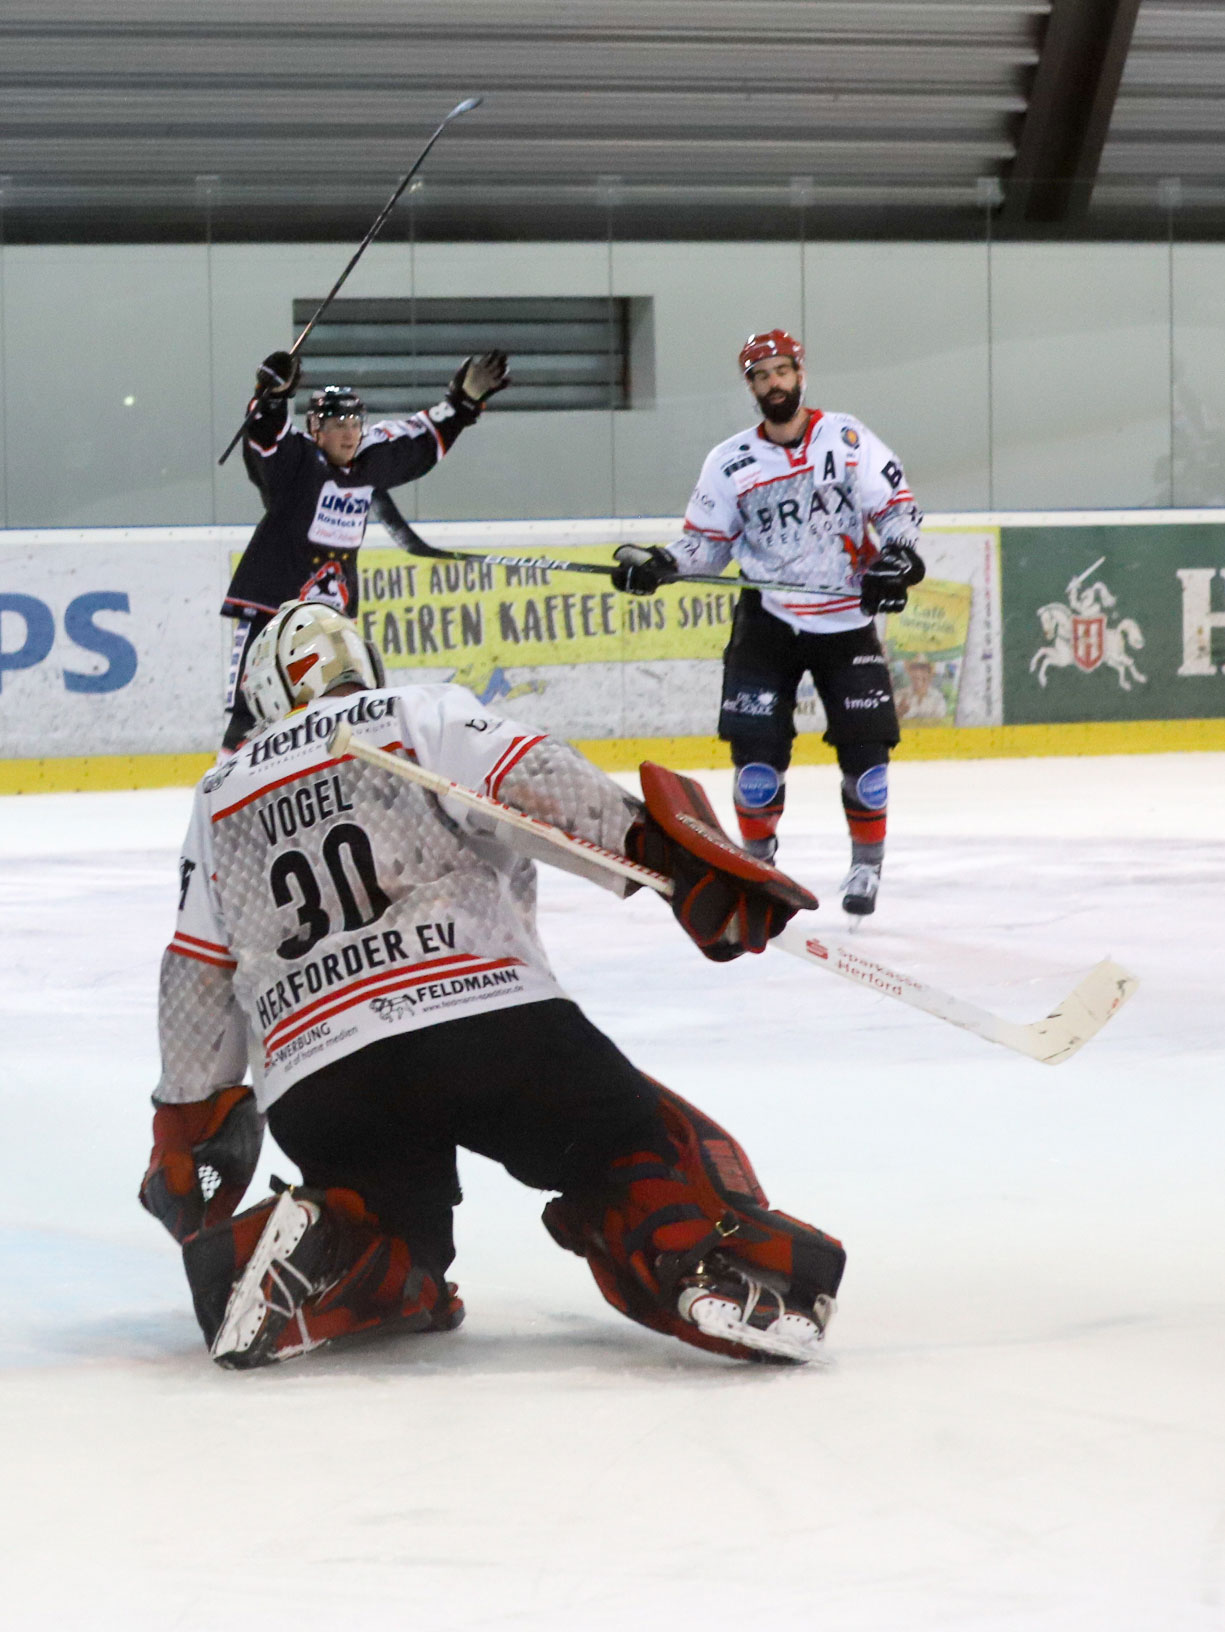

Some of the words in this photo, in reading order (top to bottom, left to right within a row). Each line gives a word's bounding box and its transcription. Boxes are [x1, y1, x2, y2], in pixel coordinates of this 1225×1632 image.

[822, 450, 837, 481] A
[756, 485, 856, 534] BRAX
[499, 592, 617, 645] KAFFEE
[246, 695, 400, 768] Herforder
[258, 775, 354, 846] VOGEL
[270, 823, 392, 960] 30
[255, 930, 409, 1029] HERFORDER
[415, 921, 456, 954] EV
[416, 968, 520, 1002] FELDMANN
[837, 946, 923, 990] Sparkasse
[837, 959, 903, 996] Herford
